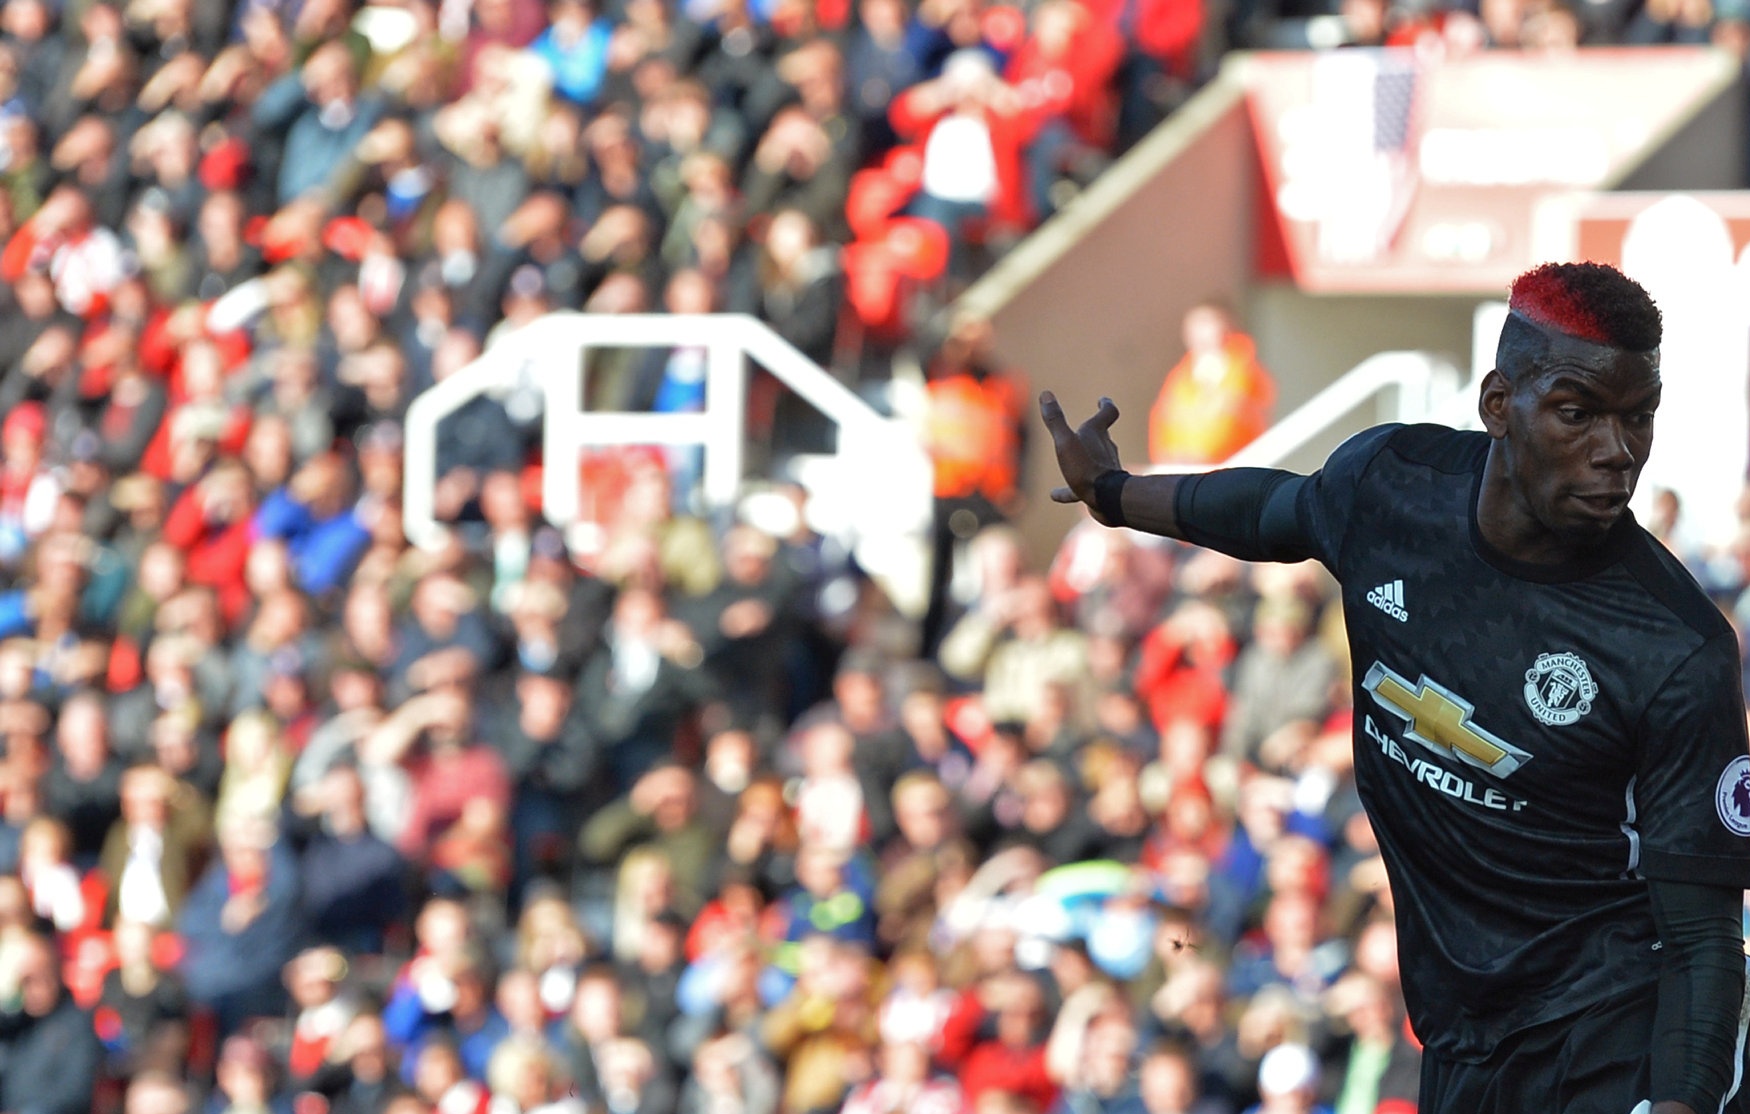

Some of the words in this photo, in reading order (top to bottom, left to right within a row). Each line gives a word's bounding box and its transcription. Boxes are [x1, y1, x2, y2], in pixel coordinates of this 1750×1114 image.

[1366, 591, 1409, 622] adidas
[1541, 658, 1591, 695] MANCHESTER
[1530, 697, 1566, 722] UNITED
